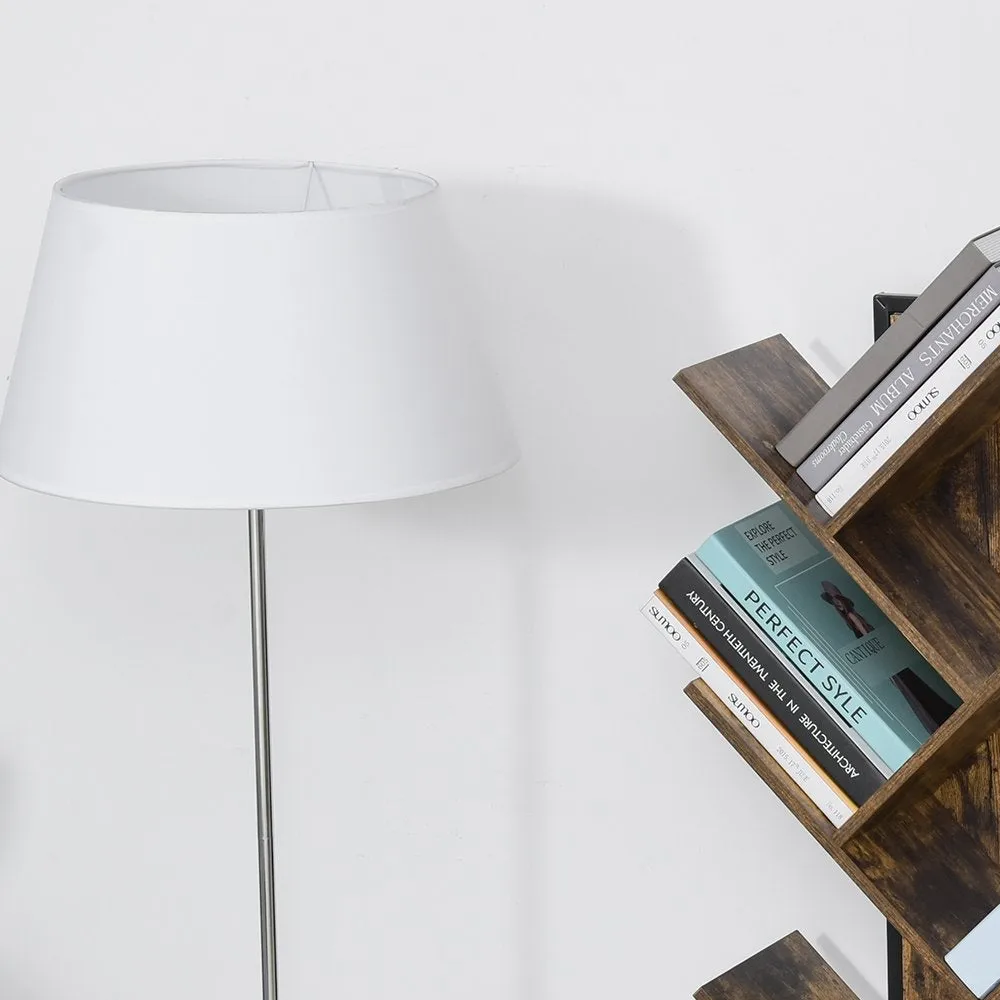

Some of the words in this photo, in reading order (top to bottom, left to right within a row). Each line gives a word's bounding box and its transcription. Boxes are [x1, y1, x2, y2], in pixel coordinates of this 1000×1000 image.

[919, 284, 998, 366] MERCHANTS
[870, 368, 915, 415] ALBUM
[812, 431, 847, 467] Cloakrooms
[744, 521, 774, 541] EXPLORE
[754, 541, 770, 553] THE
[768, 527, 798, 547] PERFECT
[766, 550, 788, 566] STYLE
[686, 592, 726, 632] CENTURY
[723, 631, 769, 680] TWENTIETH
[744, 590, 824, 670] PERFECT
[822, 676, 867, 724] SYLE
[769, 680, 790, 700] THE
[786, 699, 799, 714] IN
[799, 714, 860, 779] ARCHITECTURE
